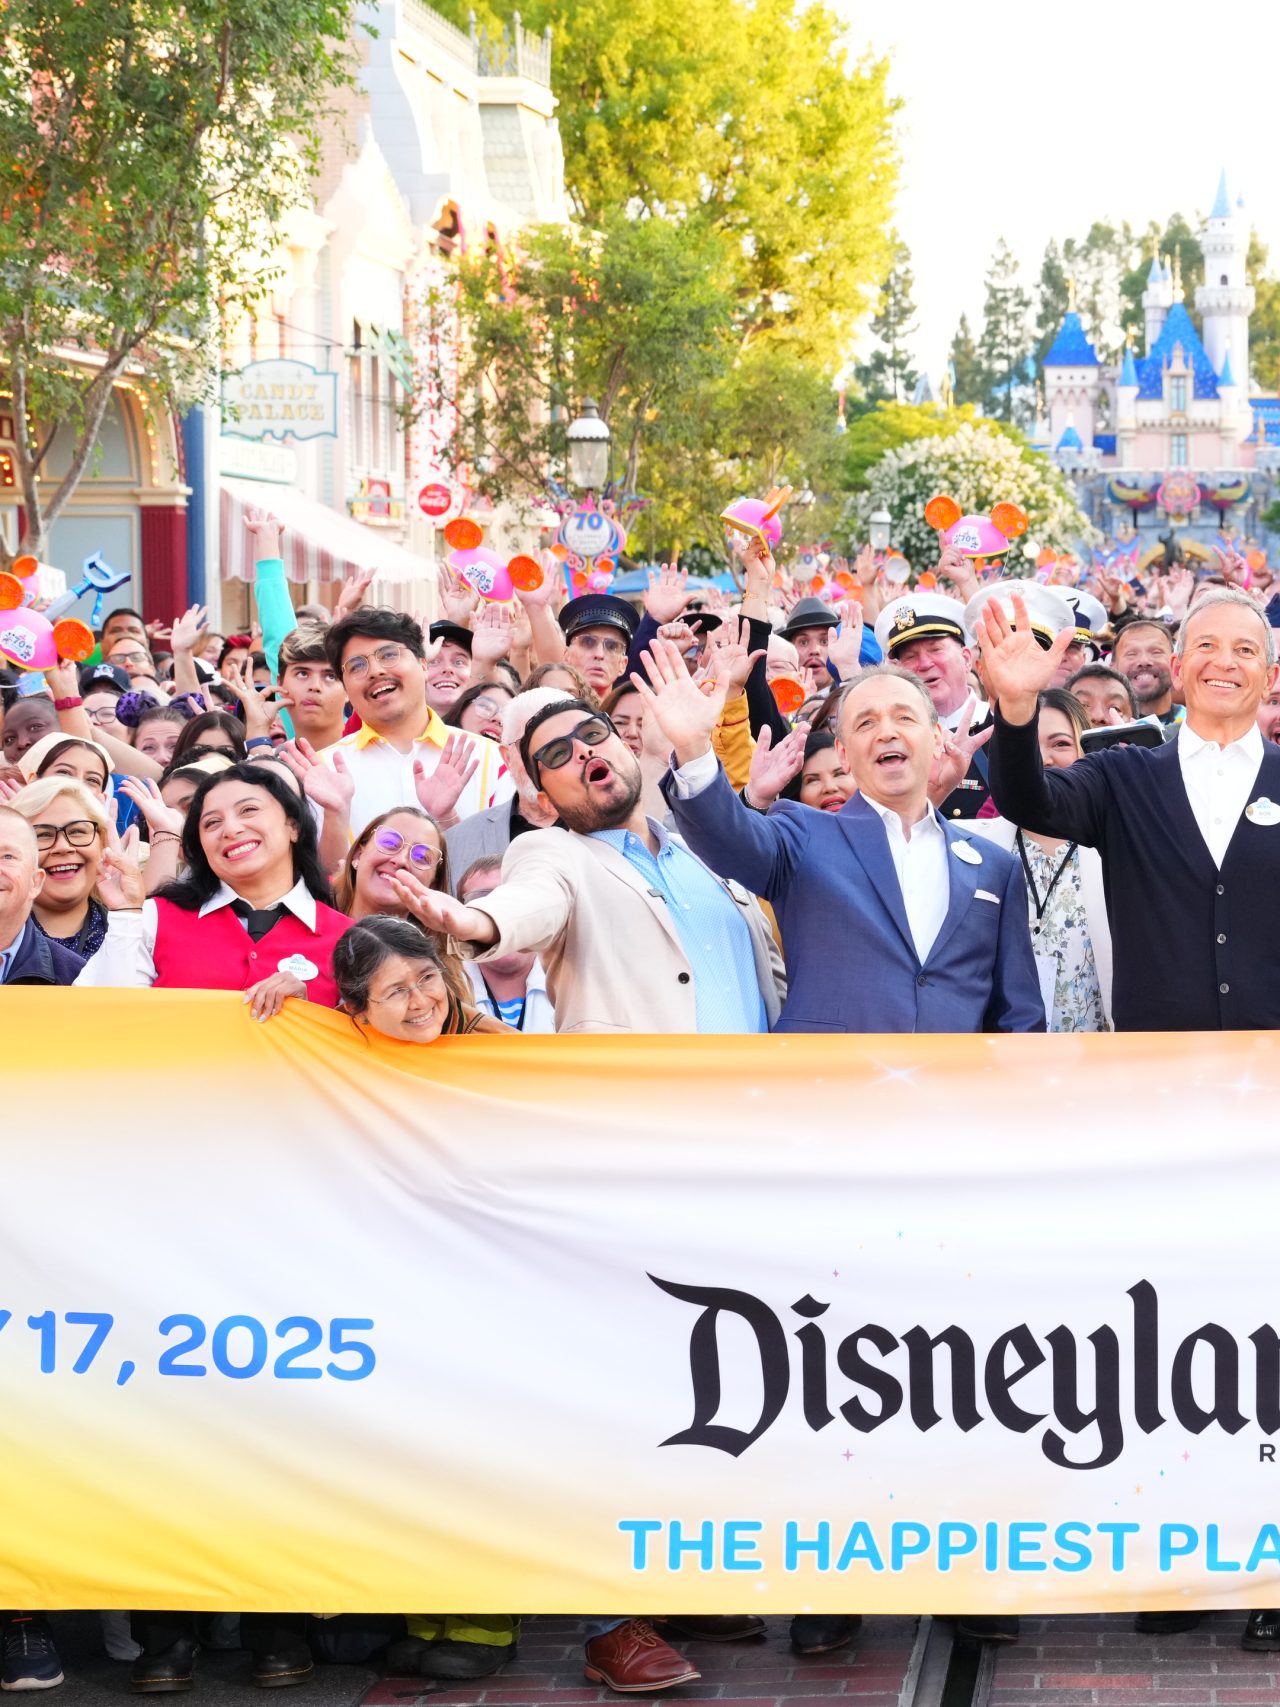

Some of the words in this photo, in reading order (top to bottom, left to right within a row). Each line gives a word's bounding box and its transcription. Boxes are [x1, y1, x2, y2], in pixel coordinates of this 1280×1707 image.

[239, 384, 319, 400] CANDY
[236, 404, 325, 421] PALACE
[575, 512, 603, 530] 70
[27, 1310, 136, 1386] 17,
[158, 1313, 376, 1381] 2025
[618, 1520, 763, 1571] THE
[785, 1520, 1140, 1572] HAPPIEST
